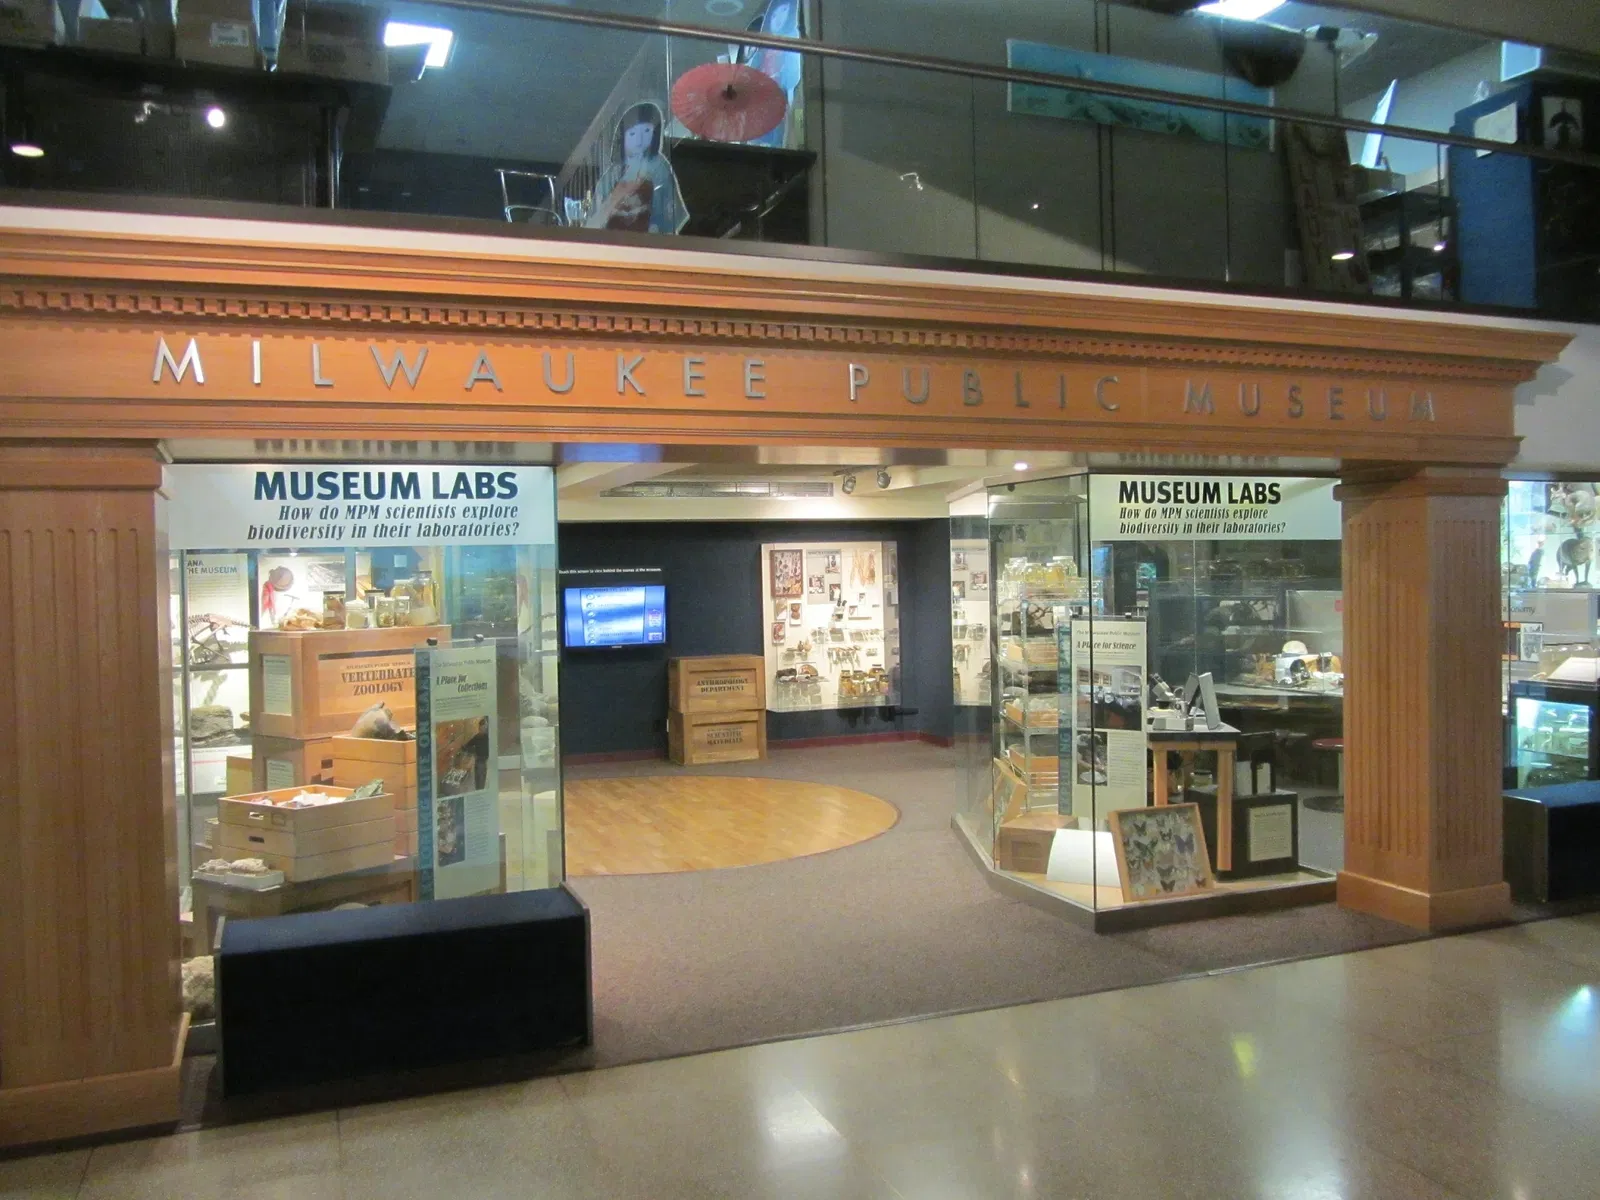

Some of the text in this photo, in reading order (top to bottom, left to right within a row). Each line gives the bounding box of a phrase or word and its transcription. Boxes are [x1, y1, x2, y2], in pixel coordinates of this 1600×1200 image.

[152, 337, 1436, 422] MILWAUKEE PUBLIC MUSEUM
[254, 471, 518, 500] MUSEUM LABS
[1119, 481, 1281, 504] MUSEUM LABS
[278, 504, 518, 520] How do MPM scientists explore
[1119, 507, 1268, 520] How do MPM scientists explore
[247, 522, 520, 540] biodiversity in their laboratories?
[1120, 521, 1286, 535] biodiversity in their laboratories?
[1081, 641, 1101, 649] Plce
[1102, 641, 1112, 649] for
[1112, 642, 1137, 650] Science
[341, 668, 415, 683] VERTEBRATE
[353, 681, 404, 696] ZOOLOGY
[457, 682, 488, 693] Collections
[700, 685, 744, 693] DEPARTMENT
